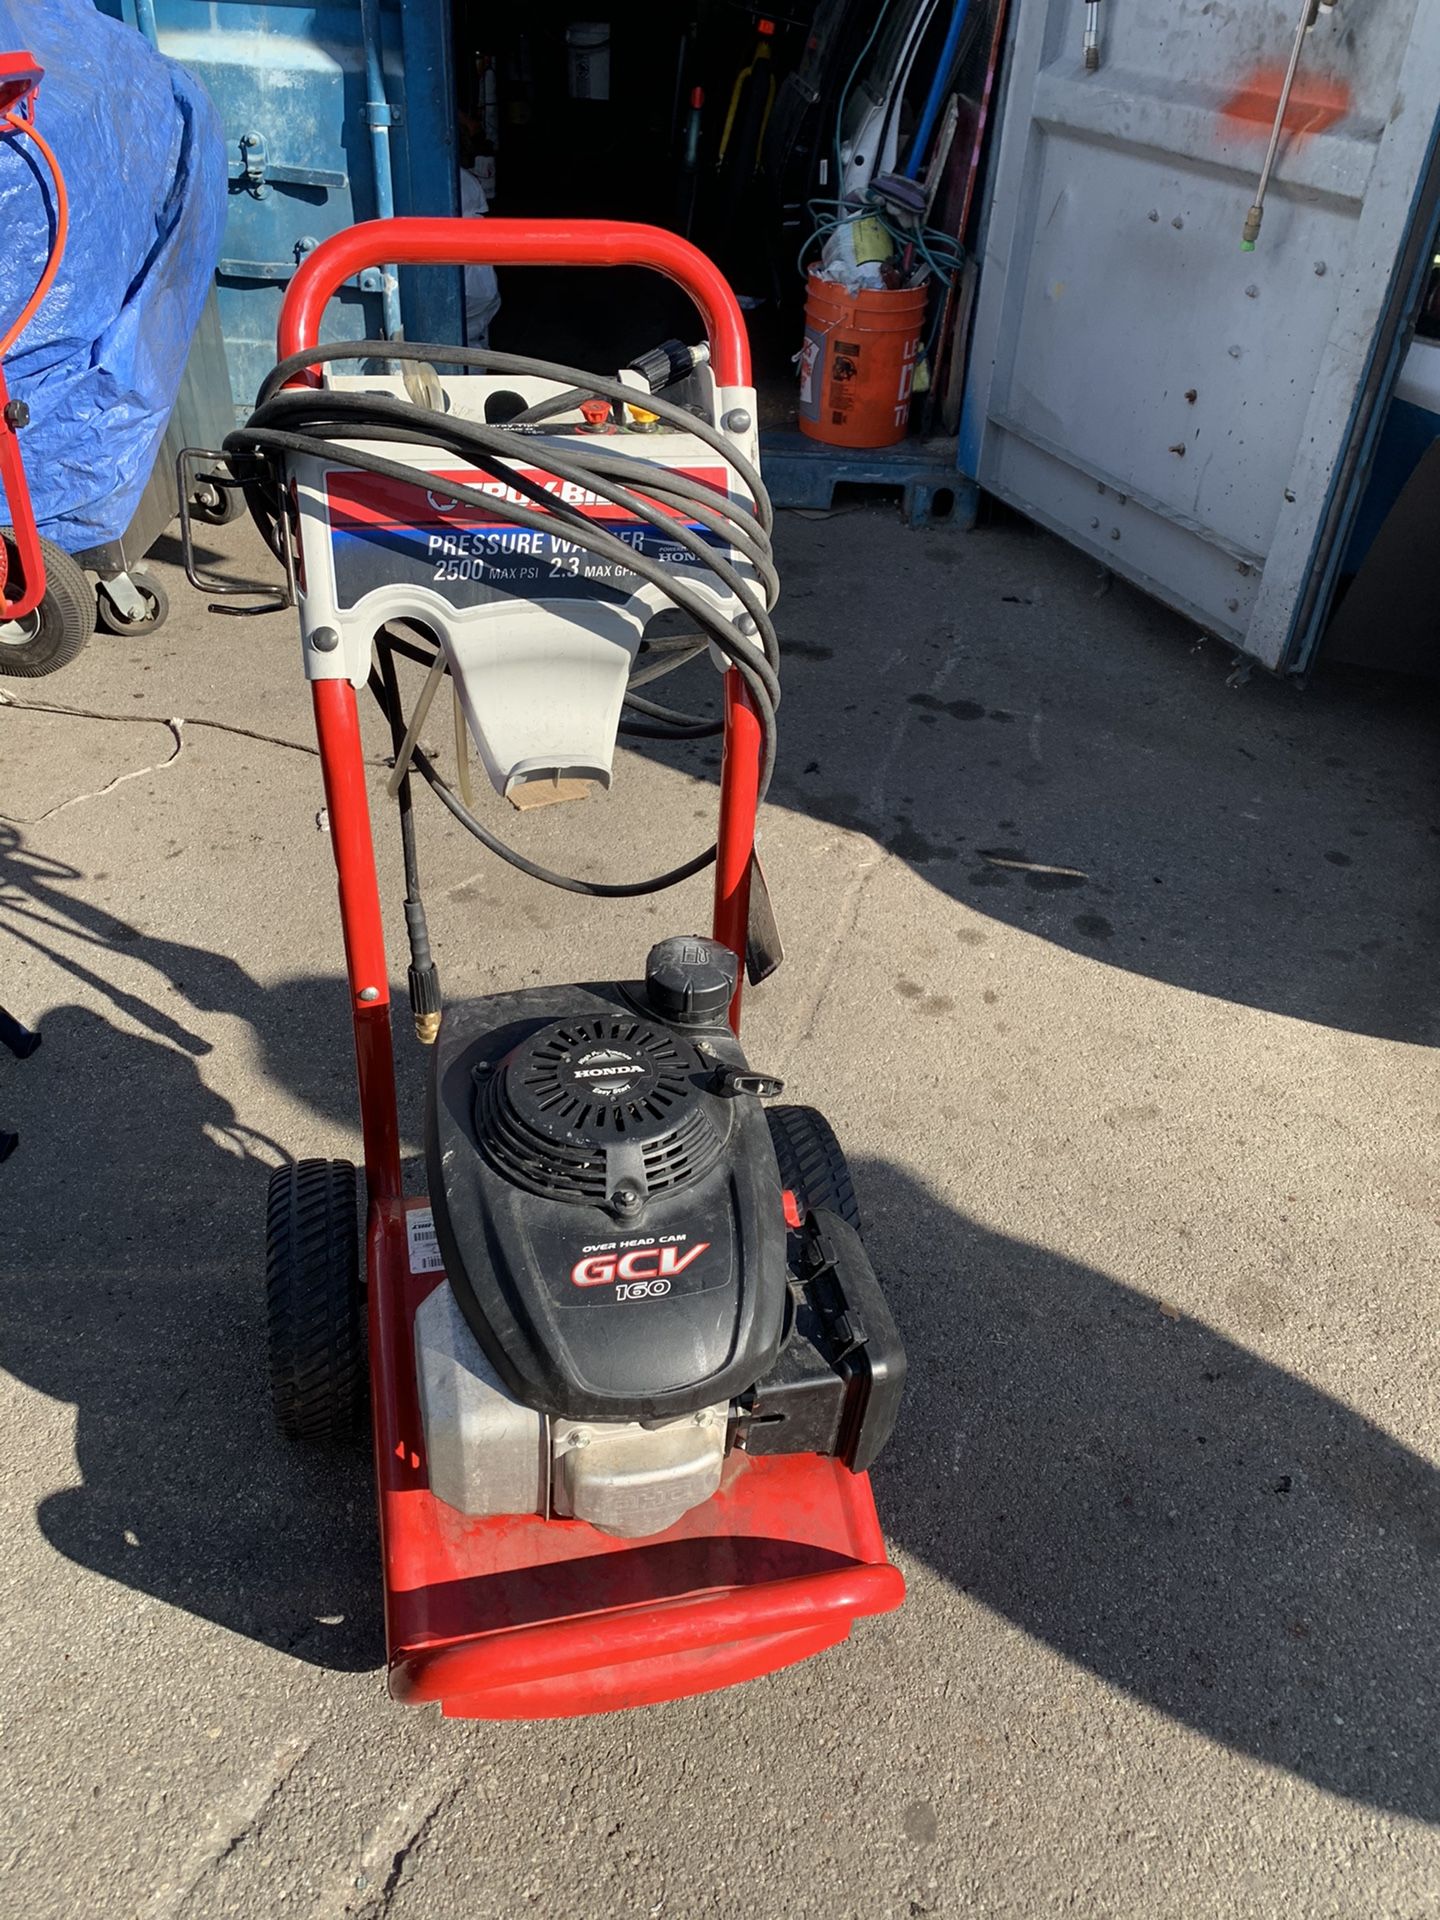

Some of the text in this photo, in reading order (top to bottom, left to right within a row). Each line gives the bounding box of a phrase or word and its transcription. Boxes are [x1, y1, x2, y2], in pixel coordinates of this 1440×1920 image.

[428, 533, 544, 555] PRESSURE
[658, 552, 701, 562] HON
[433, 559, 484, 581] 2500
[489, 567, 516, 579] MAX
[520, 567, 539, 579] PSI
[549, 557, 580, 578] 2.3
[584, 565, 612, 578] MAX
[574, 1065, 645, 1078] HONDA
[592, 1084, 631, 1096] Easy Start
[582, 1233, 687, 1253] OVER HEAD CAM
[571, 1242, 711, 1287] GCV
[616, 1279, 671, 1301] 160
